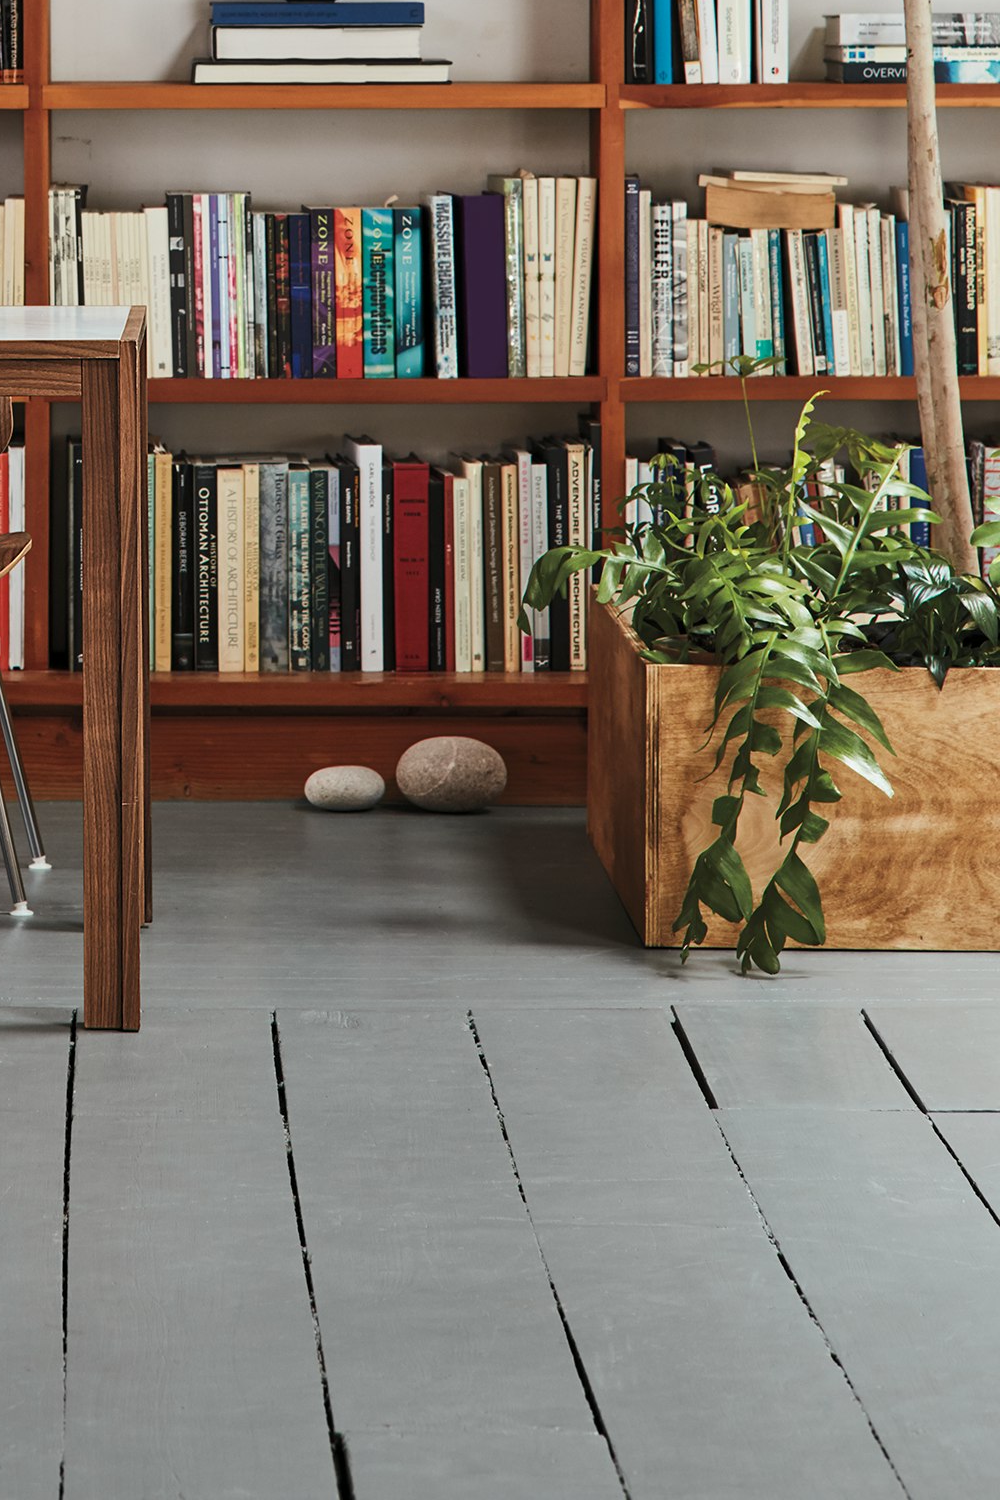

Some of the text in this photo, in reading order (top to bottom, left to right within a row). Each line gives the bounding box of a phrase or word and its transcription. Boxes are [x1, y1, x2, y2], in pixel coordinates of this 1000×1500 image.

[723, 7, 734, 32] Sophie
[863, 68, 907, 78] OVERVI
[561, 198, 569, 211] The
[317, 215, 328, 265] ZONE
[344, 217, 354, 266] ZONE
[402, 215, 412, 265] ZONE
[435, 203, 454, 310] MASSIVE CHANGE
[654, 219, 669, 280] FULLER
[965, 207, 976, 310] Modern Architecture
[576, 195, 591, 346] TUFTE VISUAL EXPLANATIONS
[366, 249, 392, 356] Incorporations
[710, 284, 721, 321] Wright
[275, 472, 284, 560] Houses of Glass
[315, 477, 325, 530] WRITING
[521, 461, 530, 545] modern chairs
[178, 511, 187, 573] DEBORAH BERKE
[316, 530, 325, 547] OF
[316, 550, 325, 574] THE
[572, 460, 581, 660] ADVENTURE ARCHITECTURE
[198, 487, 209, 644] OTTOMAN ARCHITECTURE
[211, 576, 217, 588] OF
[227, 489, 237, 649] A HISTORY OF ARCHITECTURE
[317, 575, 326, 612] WALLS
